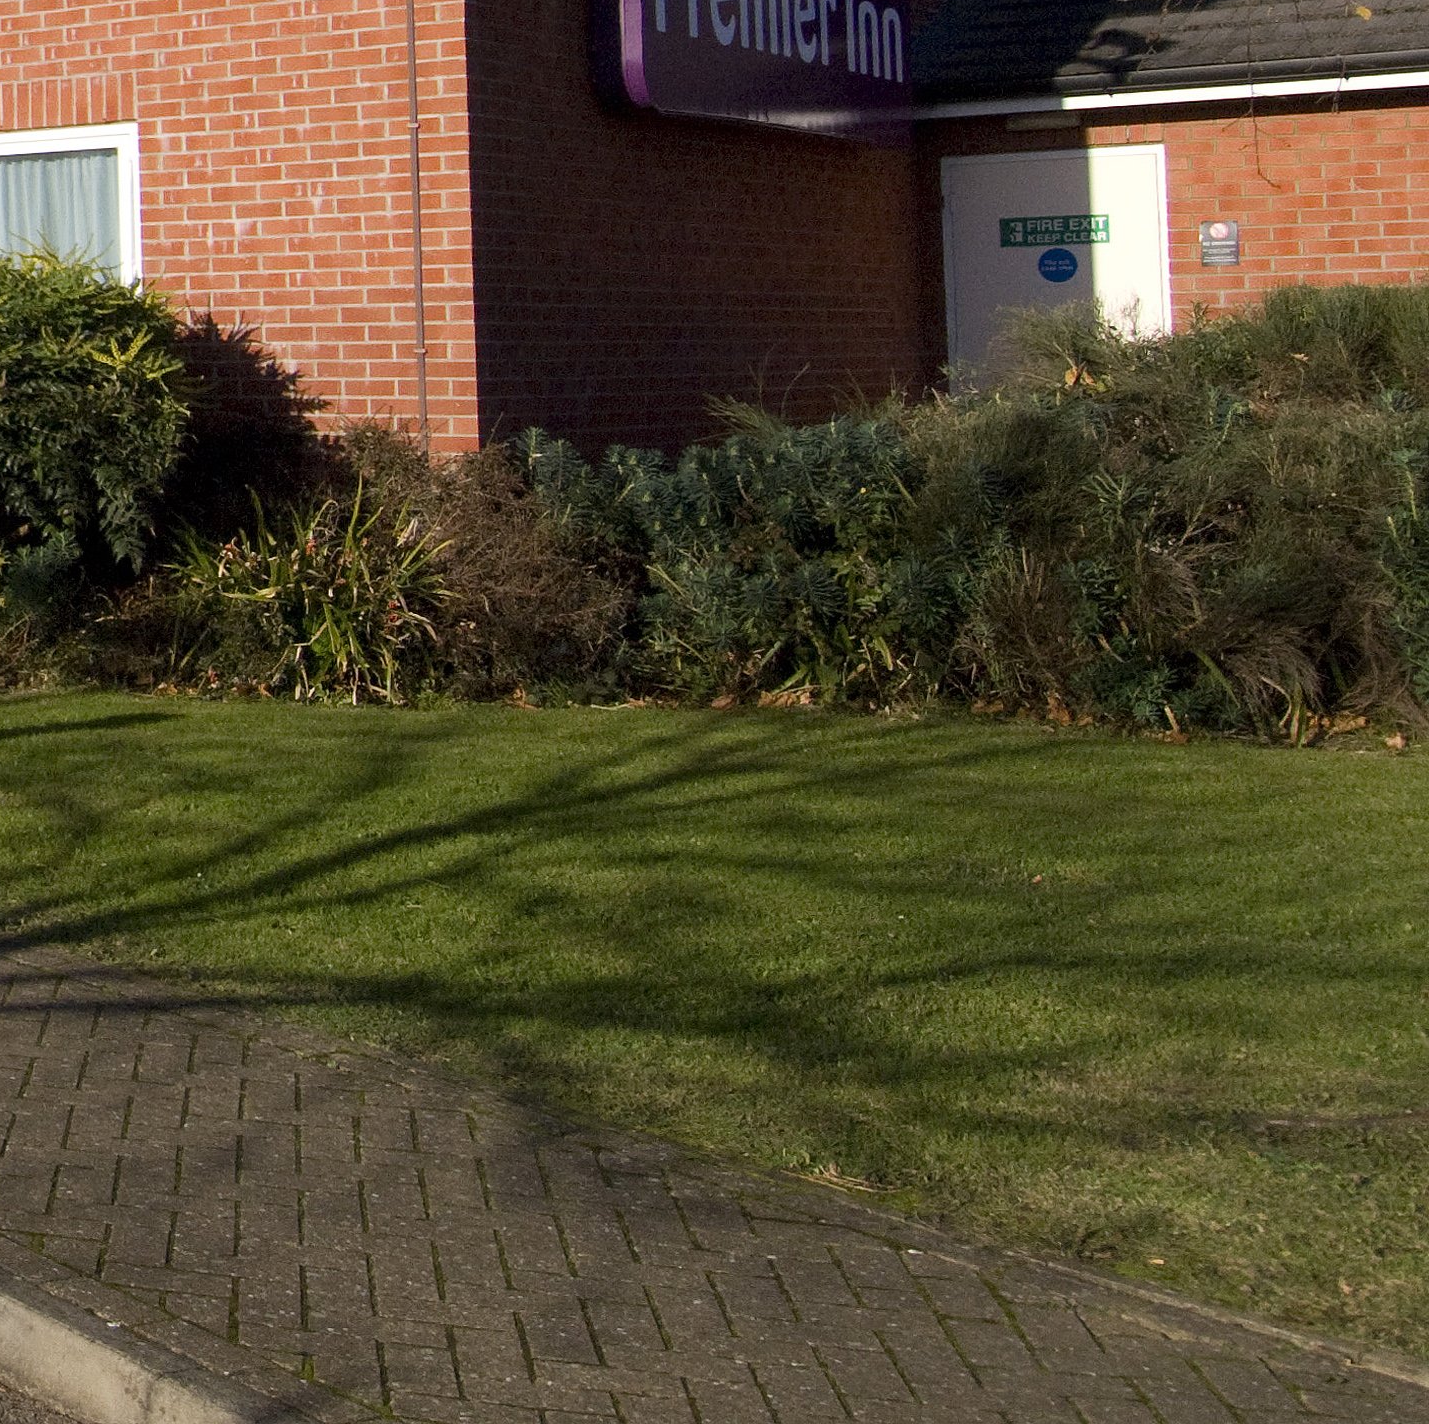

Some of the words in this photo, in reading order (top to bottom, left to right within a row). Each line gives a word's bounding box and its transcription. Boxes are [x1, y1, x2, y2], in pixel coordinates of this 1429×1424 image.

[1026, 219, 1064, 232] FIRE
[1069, 217, 1107, 231] EXIT
[1027, 233, 1062, 244] KEEP
[1063, 231, 1107, 243] CLEAR
